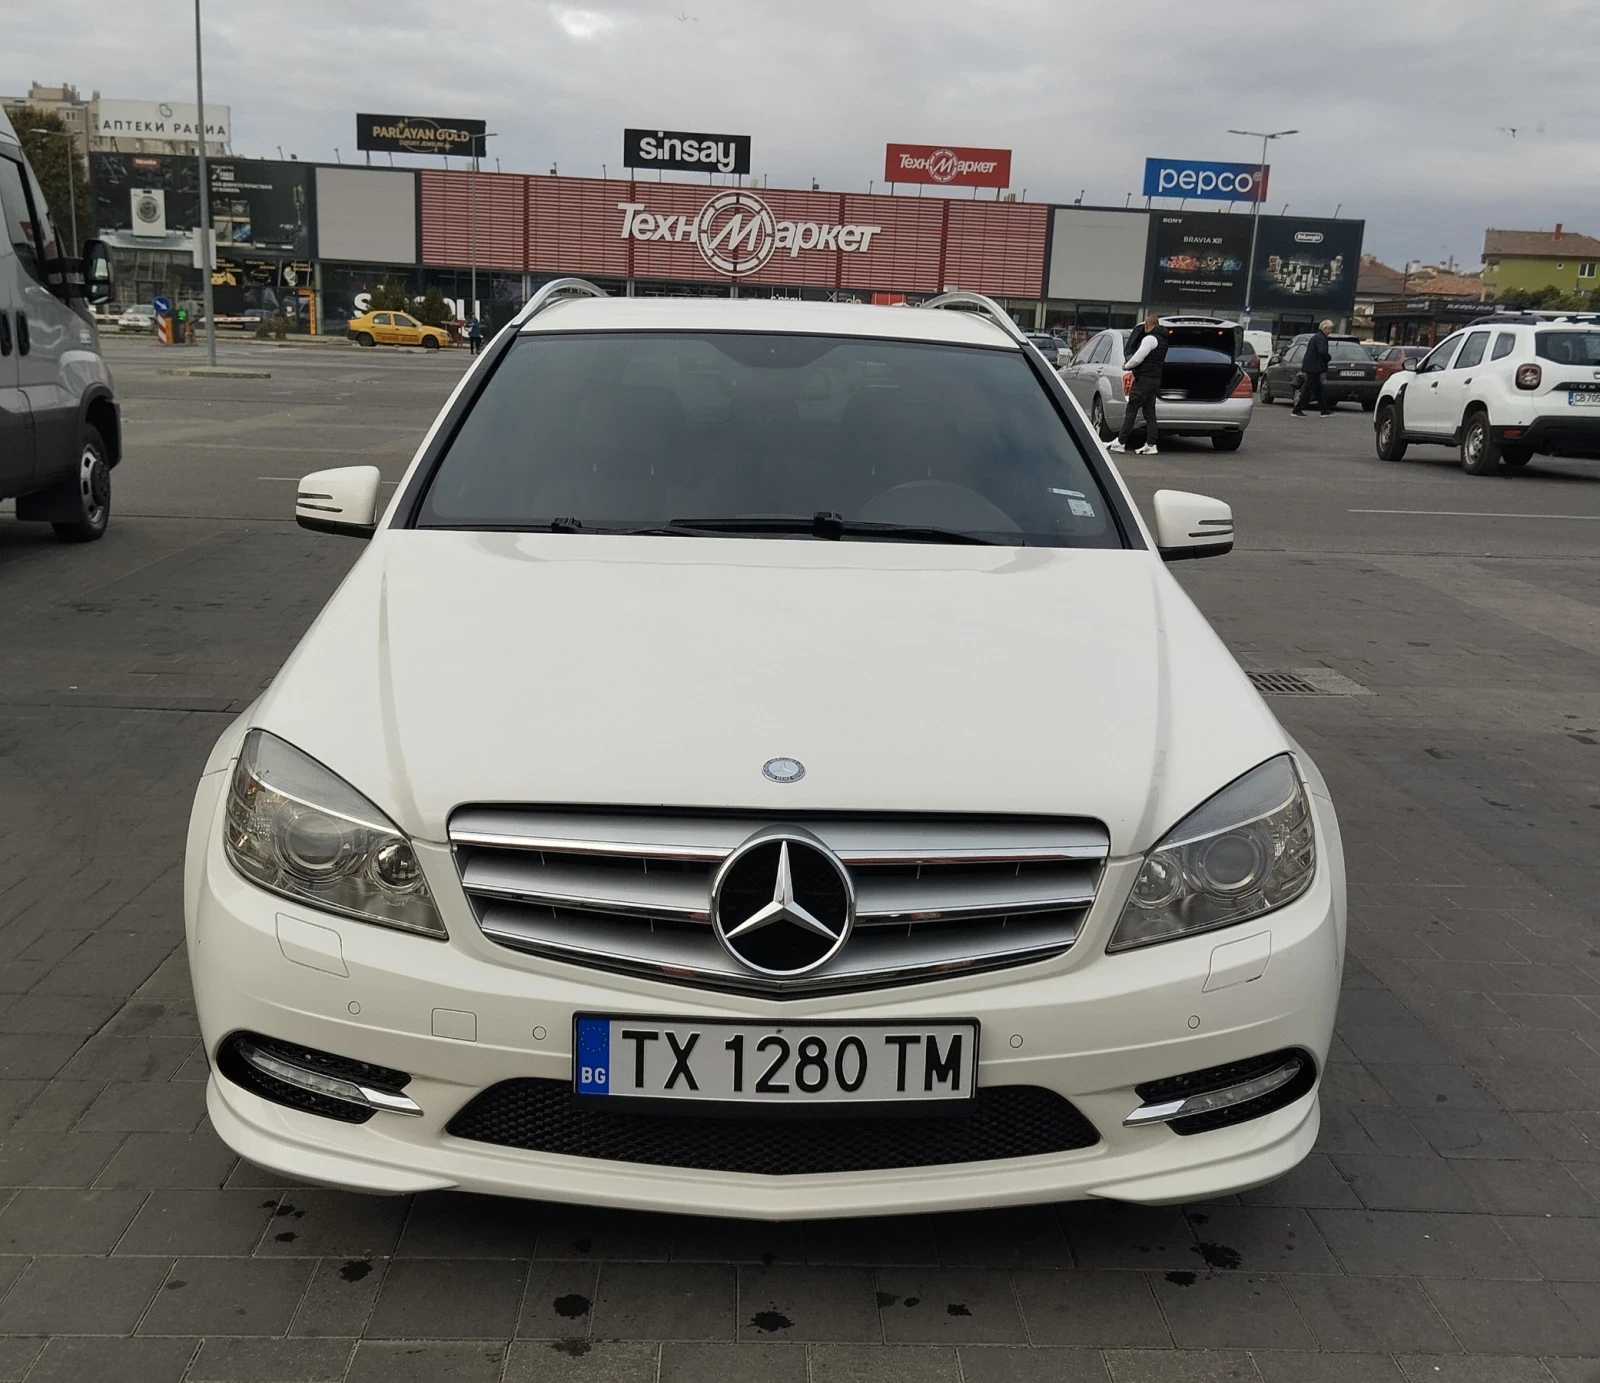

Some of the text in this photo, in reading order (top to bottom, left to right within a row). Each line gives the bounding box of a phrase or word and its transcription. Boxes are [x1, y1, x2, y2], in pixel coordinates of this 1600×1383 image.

[103, 119, 165, 132] АПТЕКИ
[372, 126, 470, 142] PARLAYAN GOLD
[639, 131, 736, 173] sinsay
[1183, 236, 1223, 245] BRAVIA XR
[1575, 393, 1586, 402] CB
[621, 1029, 962, 1094] TX 1280 TM
[581, 1066, 606, 1085] BG
